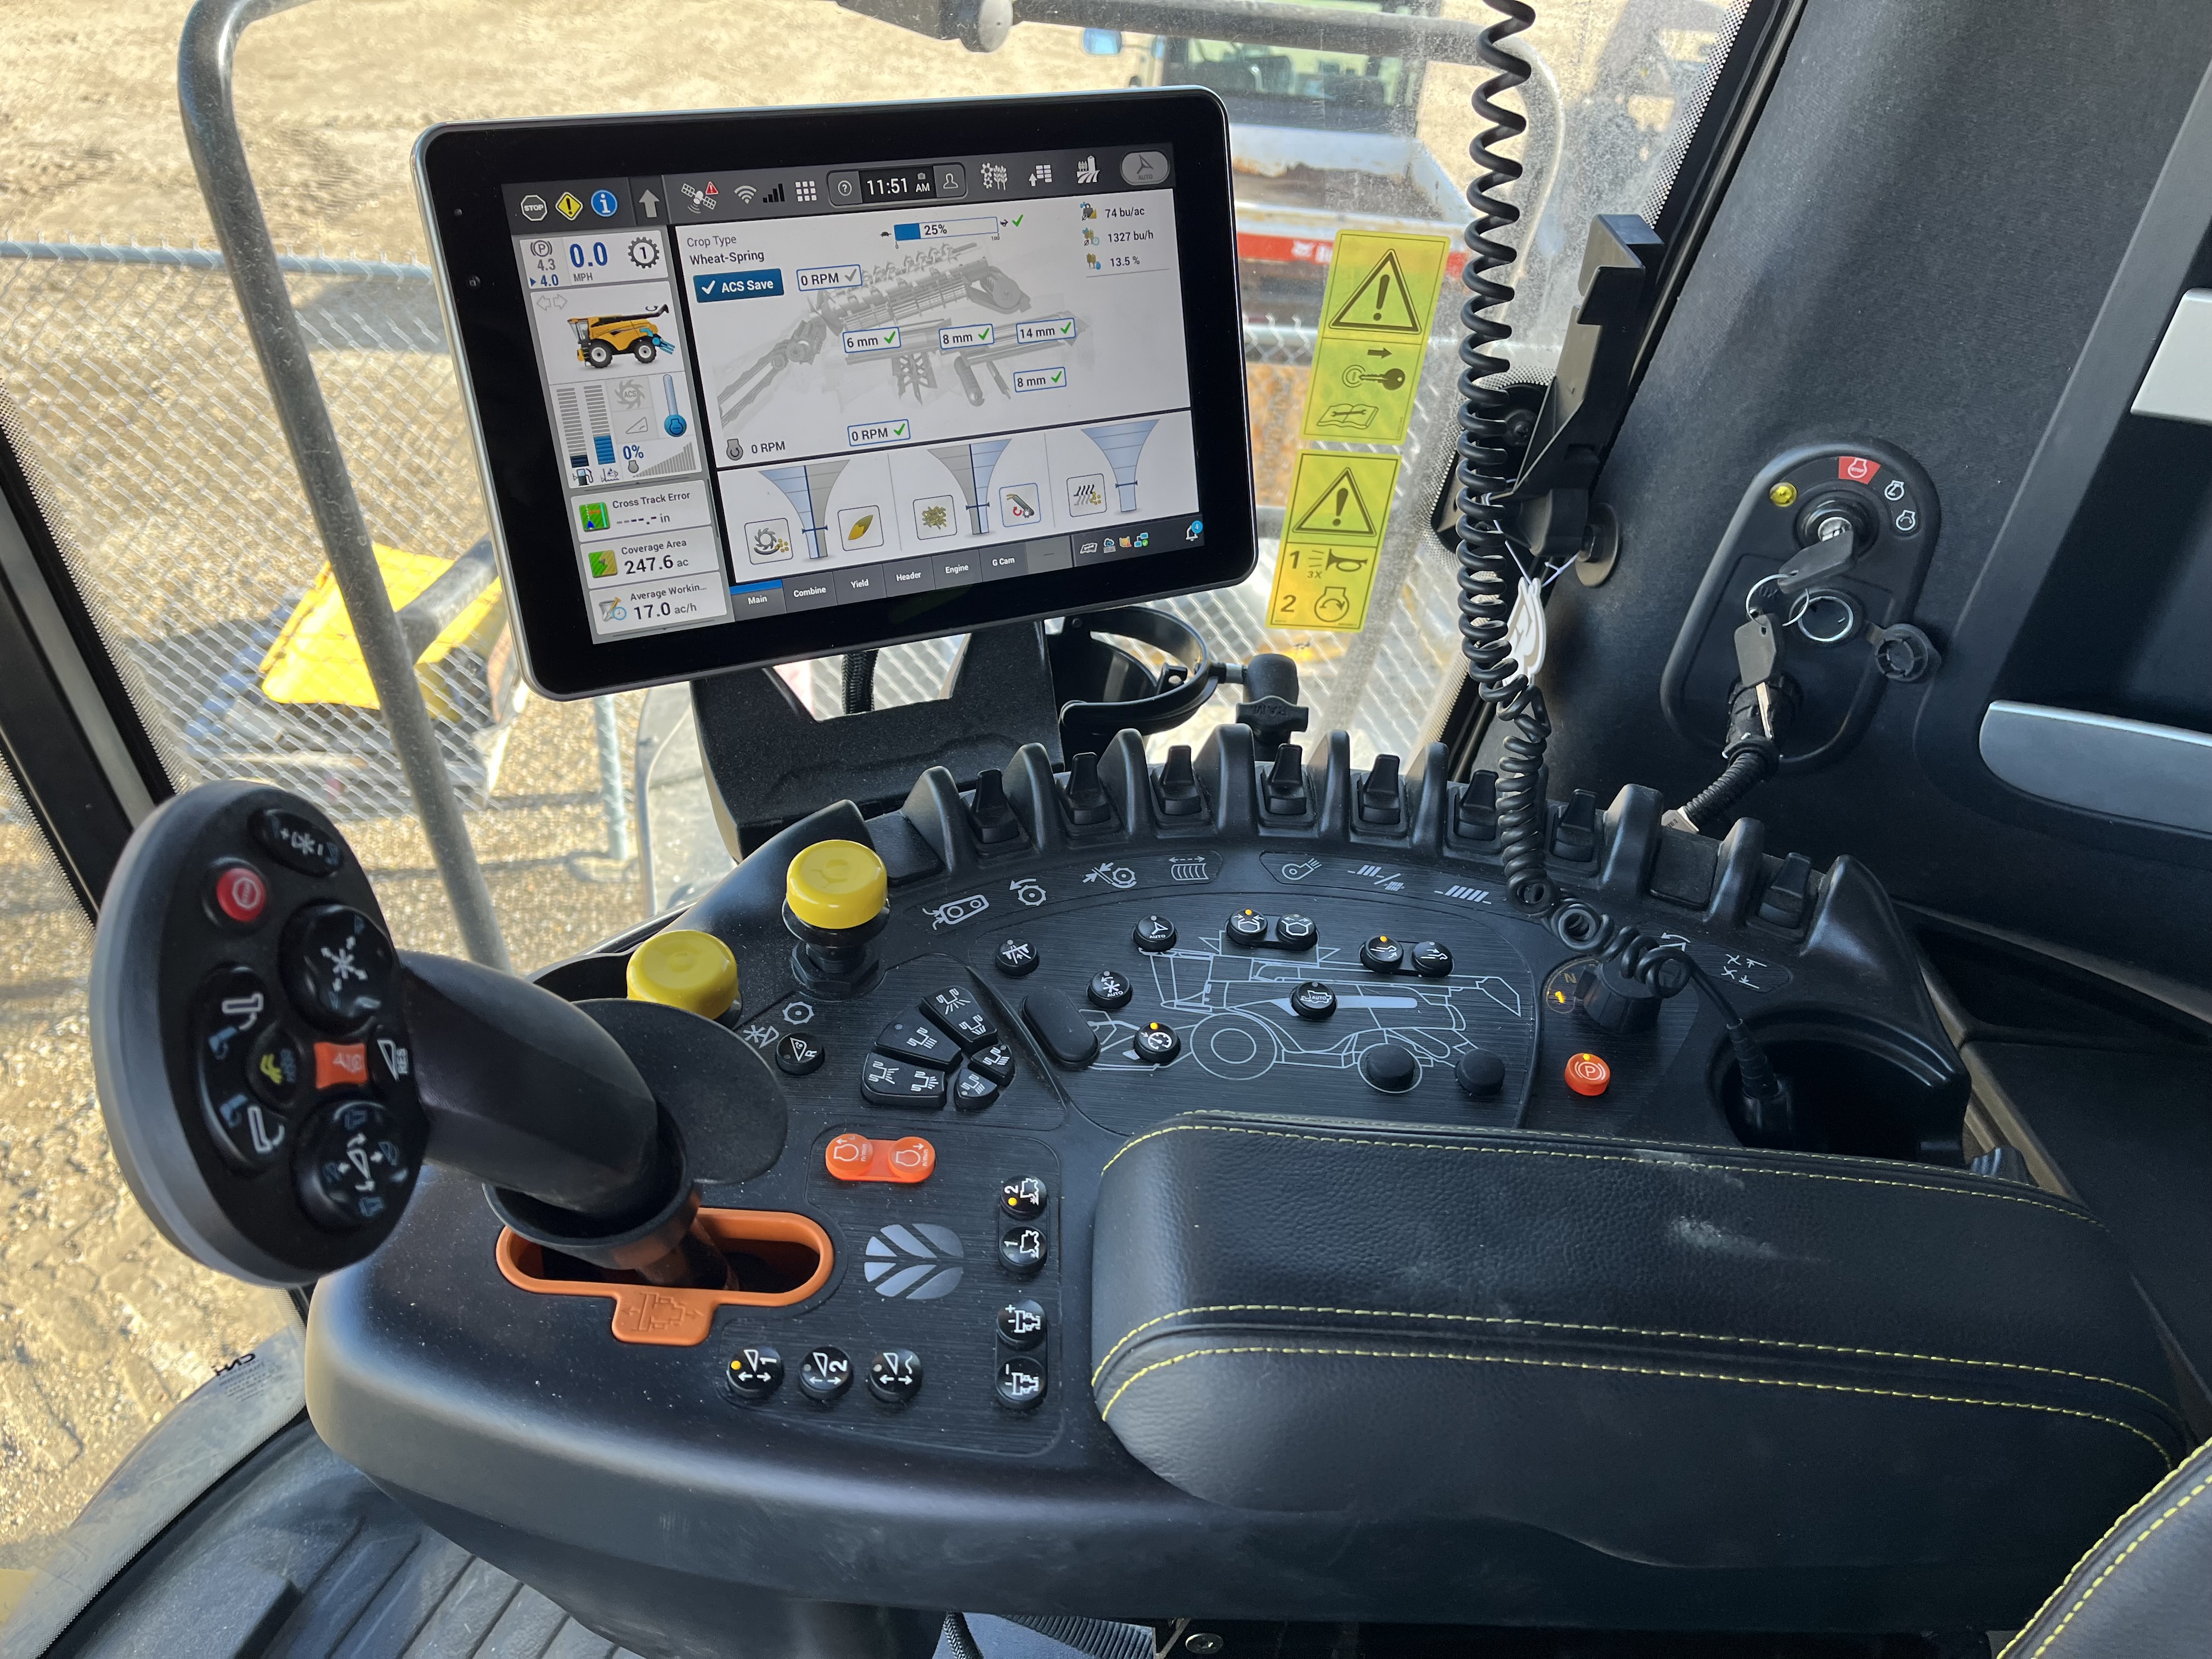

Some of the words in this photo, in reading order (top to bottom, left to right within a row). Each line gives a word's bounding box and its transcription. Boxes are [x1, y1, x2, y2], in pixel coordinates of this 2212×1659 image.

[867, 178, 909, 195] 11:51
[916, 183, 930, 193] AM
[1105, 208, 1118, 218] 74
[1119, 207, 1146, 217] bu/ac
[923, 224, 948, 236] 25%
[687, 236, 711, 248] Crop
[713, 235, 737, 246] Type
[1108, 232, 1131, 243] 1327
[1133, 230, 1154, 242] bu/h
[538, 244, 546, 253] P
[640, 247, 647, 260] 1
[569, 242, 608, 268] 0.0
[690, 251, 765, 266] Wheat-Spring
[537, 259, 556, 272] 4.3
[1110, 257, 1131, 268] 13.5
[1132, 256, 1141, 266] %
[540, 274, 559, 287] 4.0
[573, 273, 594, 283] MPH
[800, 275, 808, 286] 0
[812, 273, 839, 285] RPM
[721, 281, 744, 294] ACS
[747, 279, 774, 292] Save
[943, 334, 950, 345] 8
[953, 333, 973, 344] mm
[1020, 328, 1033, 340] 14
[1036, 327, 1056, 337] mm
[847, 337, 854, 348] 6
[857, 337, 879, 348] mm
[1017, 377, 1024, 387] 8
[1026, 376, 1046, 386] mm
[624, 390, 637, 398] ACS
[851, 431, 859, 442] 0
[862, 428, 888, 440] RPM
[623, 444, 644, 460] 0%
[751, 444, 758, 454] 0
[761, 441, 786, 453] RPM
[612, 498, 639, 509] Cross
[640, 495, 666, 506] Track
[668, 492, 691, 502] Error
[659, 513, 670, 523] in
[621, 543, 664, 556] Coverage
[666, 539, 687, 549] Area
[624, 555, 674, 575] 247.6
[677, 558, 689, 567] ac
[991, 558, 998, 567] G
[999, 556, 1015, 566] Cam
[1289, 550, 1300, 569] 1
[945, 563, 969, 575] Engine
[1307, 571, 1323, 579] 3X
[896, 571, 922, 582] Header
[850, 578, 870, 589] Yield
[630, 589, 667, 601] Average
[793, 585, 827, 597] Combine
[748, 595, 768, 605] Main
[1280, 595, 1297, 613] 2
[634, 602, 671, 620] 17.0
[674, 602, 697, 614] ac/h
[1564, 973, 1577, 984] N
[1584, 1065, 1596, 1077] P
[1005, 1185, 1019, 1195] 2
[760, 1356, 777, 1365] 1
[828, 1359, 848, 1373] 2
